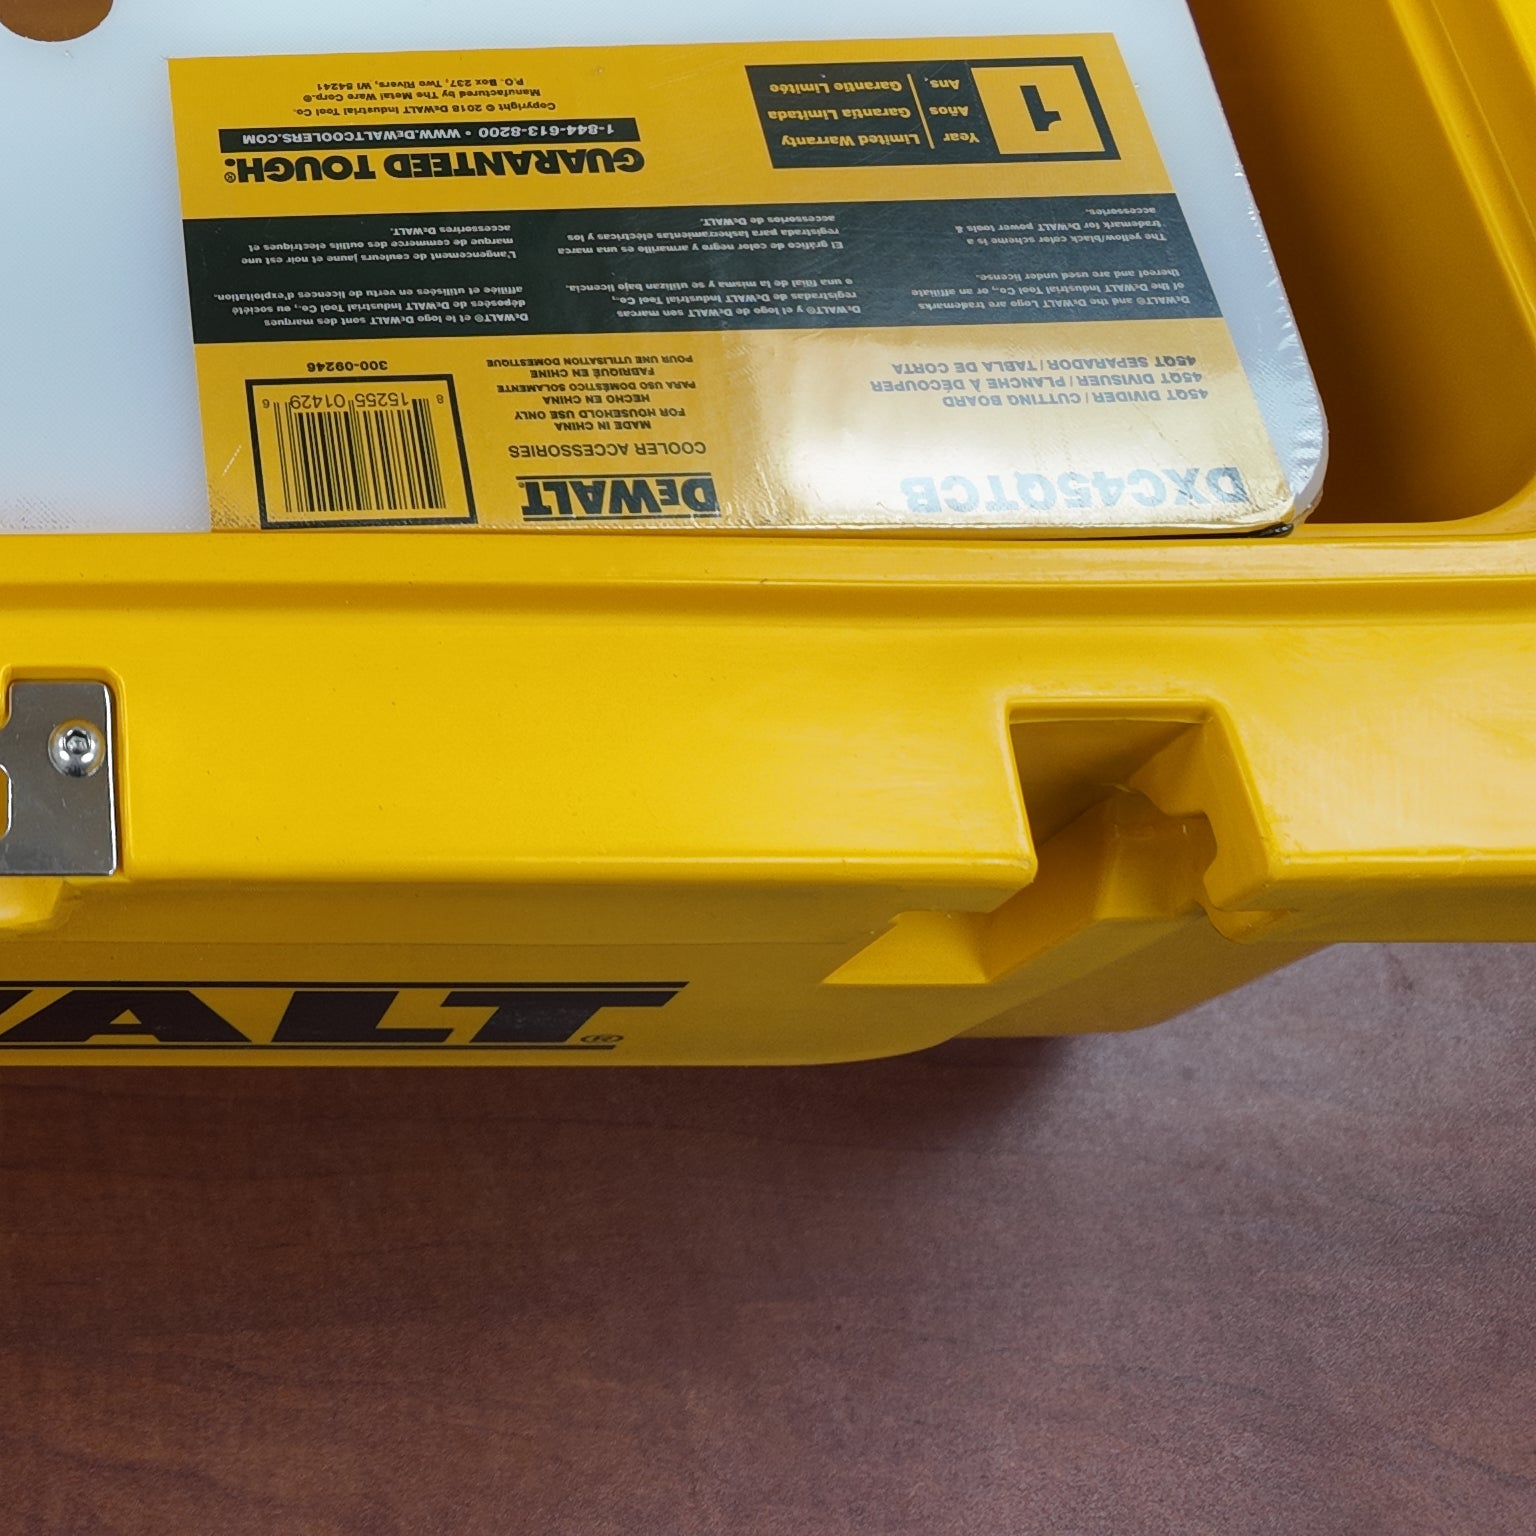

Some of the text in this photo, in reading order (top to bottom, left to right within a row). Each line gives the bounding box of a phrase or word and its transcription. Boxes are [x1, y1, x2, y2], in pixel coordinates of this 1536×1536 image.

[316, 77, 524, 91] P.O. Box 237, Two Rivers, WI 54241
[768, 78, 960, 95] Ans Garantie Limitée
[347, 92, 377, 102] Ware
[379, 91, 413, 101] Metal
[416, 90, 439, 100] The
[441, 89, 456, 99] by
[459, 88, 541, 99] Manufactured
[343, 105, 400, 116] Industrial
[452, 103, 482, 113] 2018
[498, 100, 557, 112] Copyright
[1019, 84, 1062, 132] 1
[293, 107, 312, 118] Co.
[315, 107, 340, 117] Tool
[767, 105, 969, 122] Años Garantía Limitada
[477, 123, 615, 139] 1-844-613-8200
[781, 132, 980, 148] Year Limited Warranty
[383, 147, 645, 179] GUARANTEED
[240, 256, 263, 265] une
[264, 256, 283, 266] est
[285, 255, 309, 265] noir
[311, 255, 324, 265] et
[326, 253, 358, 264] jaune
[360, 252, 410, 263] couleurs
[412, 252, 428, 262] de
[297, 290, 346, 300] licences
[348, 289, 363, 299] de
[365, 288, 396, 299] vertu
[398, 288, 414, 297] en
[468, 286, 481, 296] et
[231, 305, 274, 316] société
[320, 303, 345, 314] Tool
[347, 301, 403, 313] Industrial
[453, 300, 468, 310] de
[263, 317, 314, 328] marques
[316, 317, 338, 327] des
[340, 316, 367, 326] sont
[416, 313, 443, 324] logo
[445, 314, 457, 324] le
[459, 314, 472, 323] et
[306, 360, 388, 373] 300-09246
[486, 354, 694, 368] POUR UNE UTILISATION DOMESTIQUE
[891, 354, 1197, 375] 45QT SEPARADOR TABLA DE CORTA
[529, 366, 656, 379] FABRIQUÉ EN CHINE
[496, 380, 697, 393] PARA USO DOMÉSTICO SOLAMENTE
[869, 371, 1203, 394] 45QT DIVISUER PLANCHE À DÉCOUPER
[261, 391, 444, 409] 8 15255 01429 6
[542, 393, 651, 405] HECHO EN CHINA
[942, 388, 1209, 408] 45QT DIVIDER CUTTING BOARD
[514, 407, 686, 420] FOR HOUSEHOLD USE ONLY
[553, 420, 652, 431] MADE IN CHINA
[508, 441, 706, 458] COOLER ACCESSORIES
[899, 466, 1251, 514] DXC45QTCB
